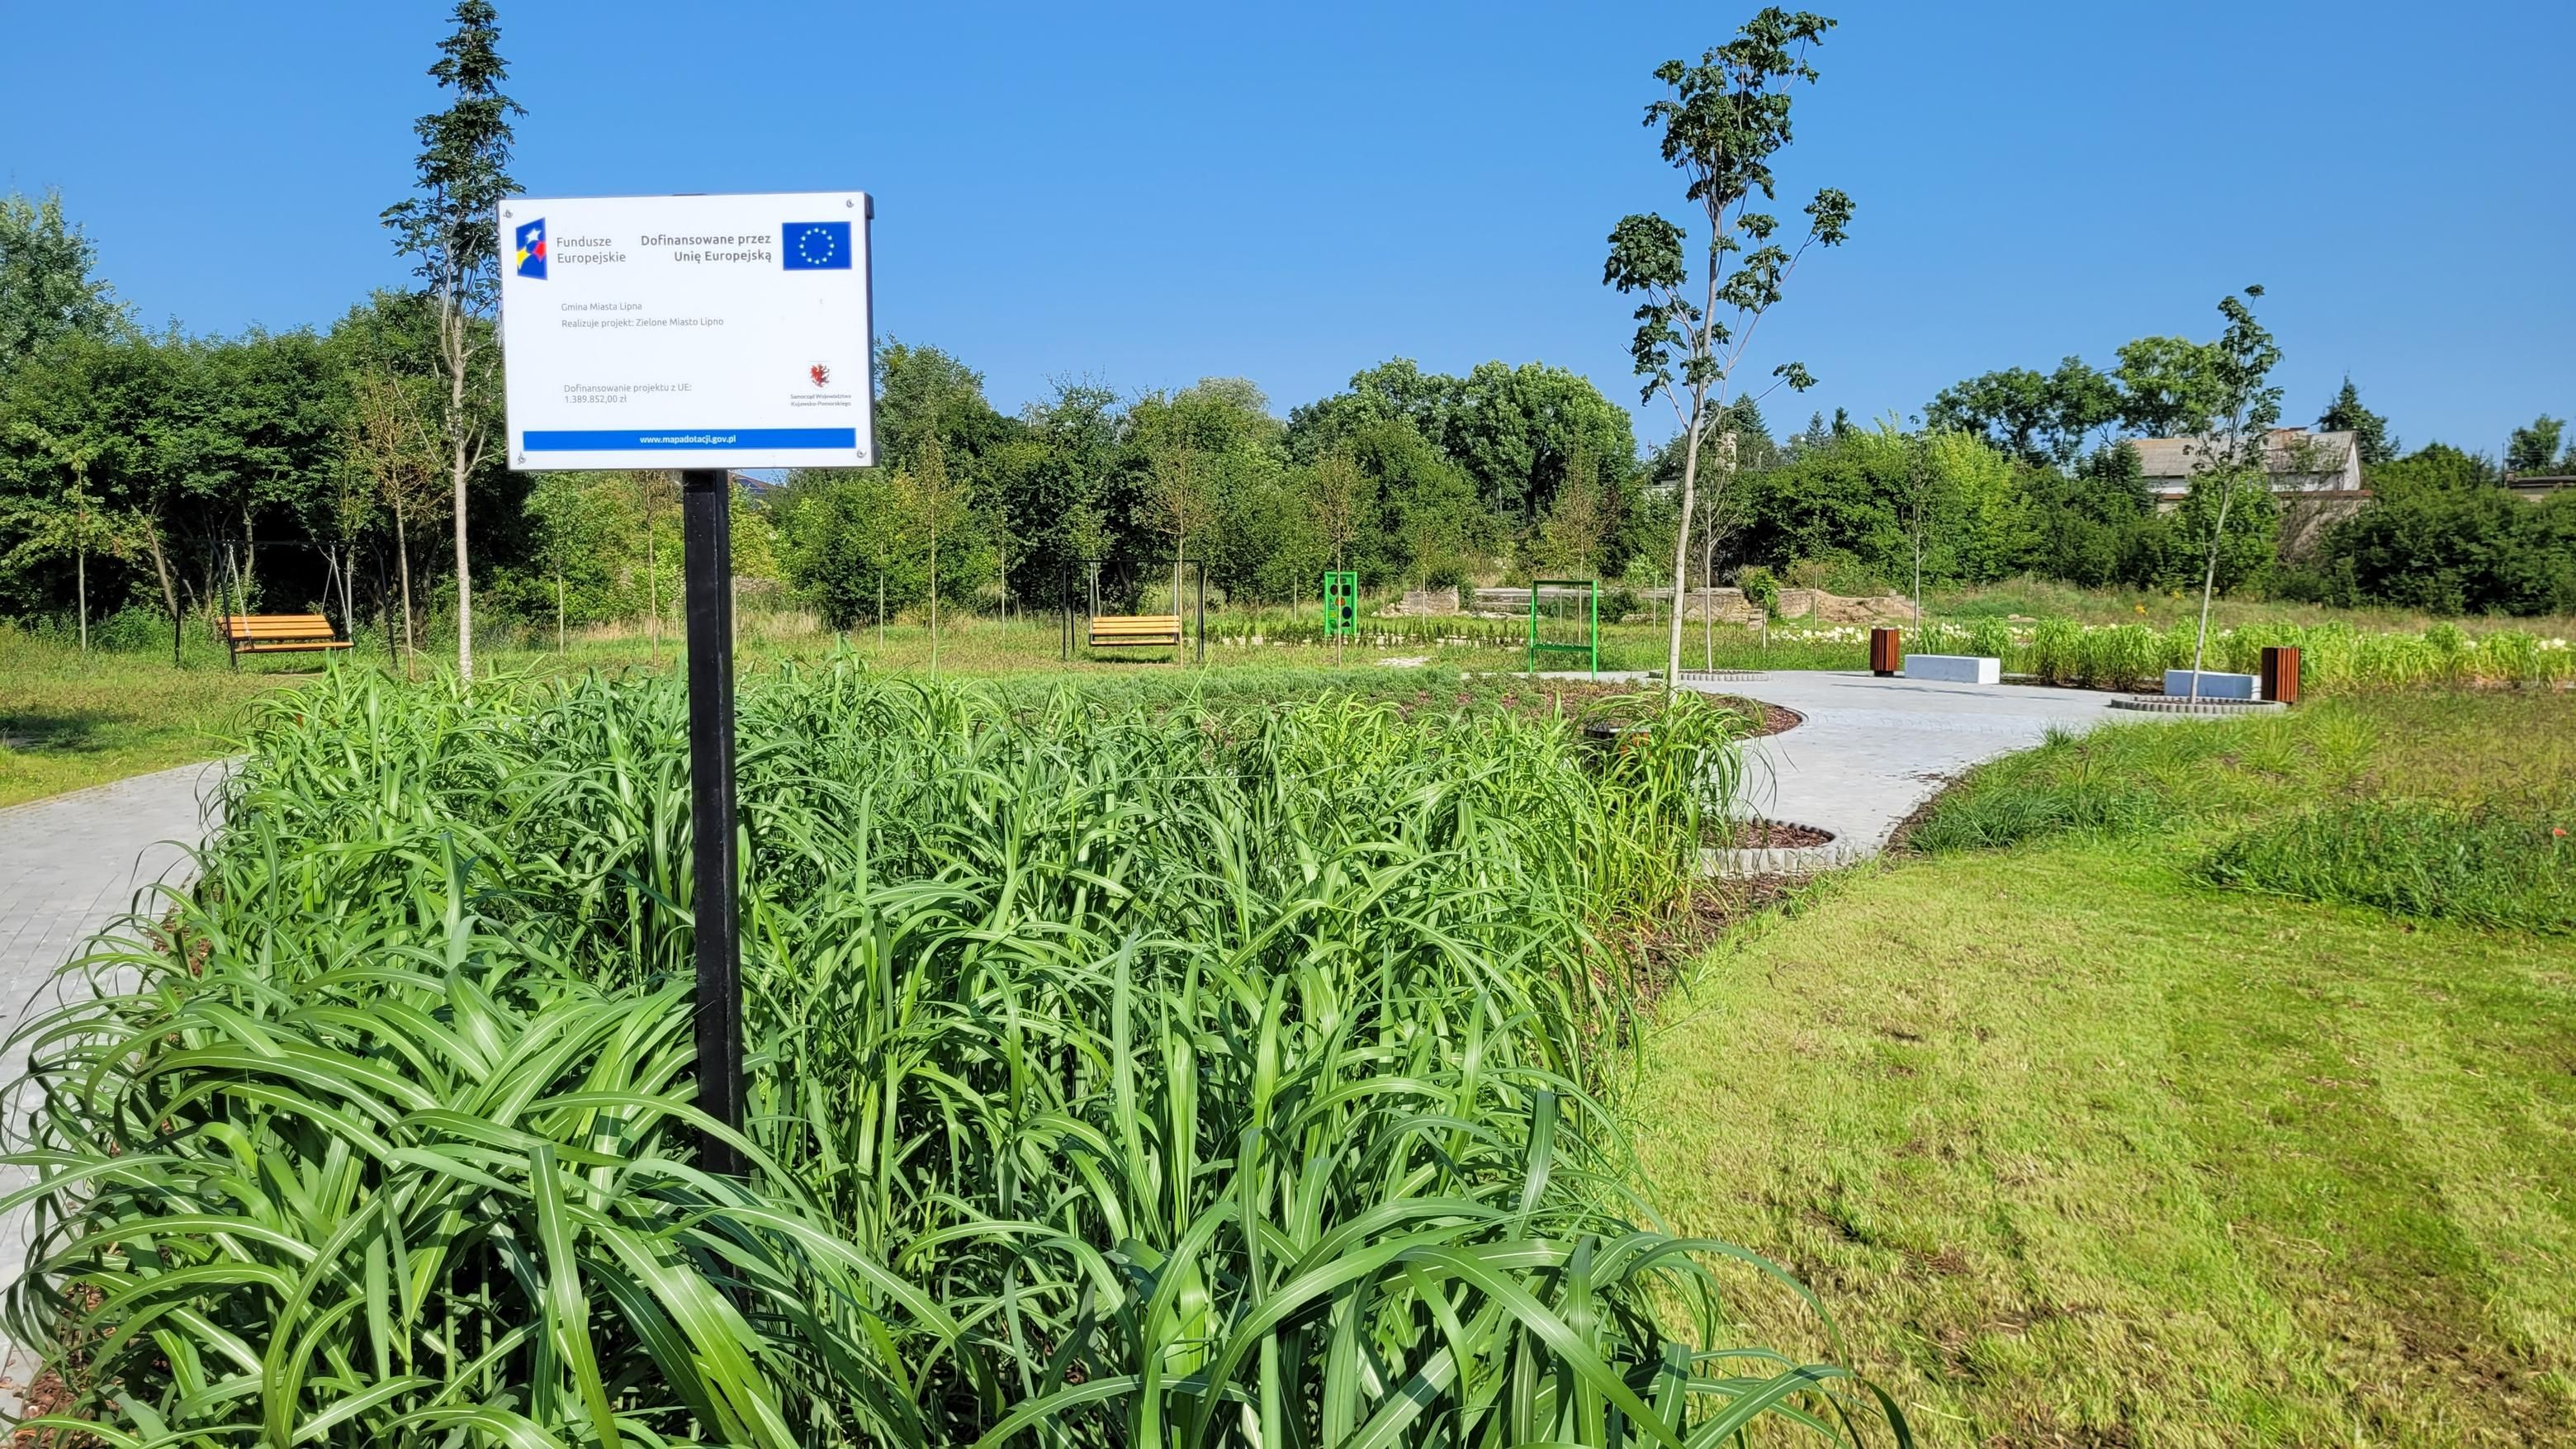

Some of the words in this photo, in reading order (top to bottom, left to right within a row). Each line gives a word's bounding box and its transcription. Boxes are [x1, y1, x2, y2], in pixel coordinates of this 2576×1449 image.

[556, 235, 612, 248] Fundusze
[641, 234, 735, 247] Dofinansowane
[738, 234, 772, 247] przez
[557, 251, 626, 265] Europejskie
[675, 250, 701, 263] Unię
[705, 249, 772, 263] Europejską
[561, 302, 588, 311] Gmina
[590, 302, 618, 310] Miasta
[620, 301, 642, 312] Lipna
[561, 319, 599, 329] Realizuje
[601, 318, 634, 329] projekt:
[636, 318, 667, 327] Zielone
[670, 317, 698, 326] Miasto
[700, 317, 724, 327] Lipno
[564, 384, 632, 393] Dofinansowanie
[633, 383, 669, 394] projektu
[678, 383, 692, 392] UE:
[565, 395, 618, 405] 1.389.852,00
[619, 395, 627, 404] zł
[640, 434, 736, 445] www.mapadotacji.gov.pl
